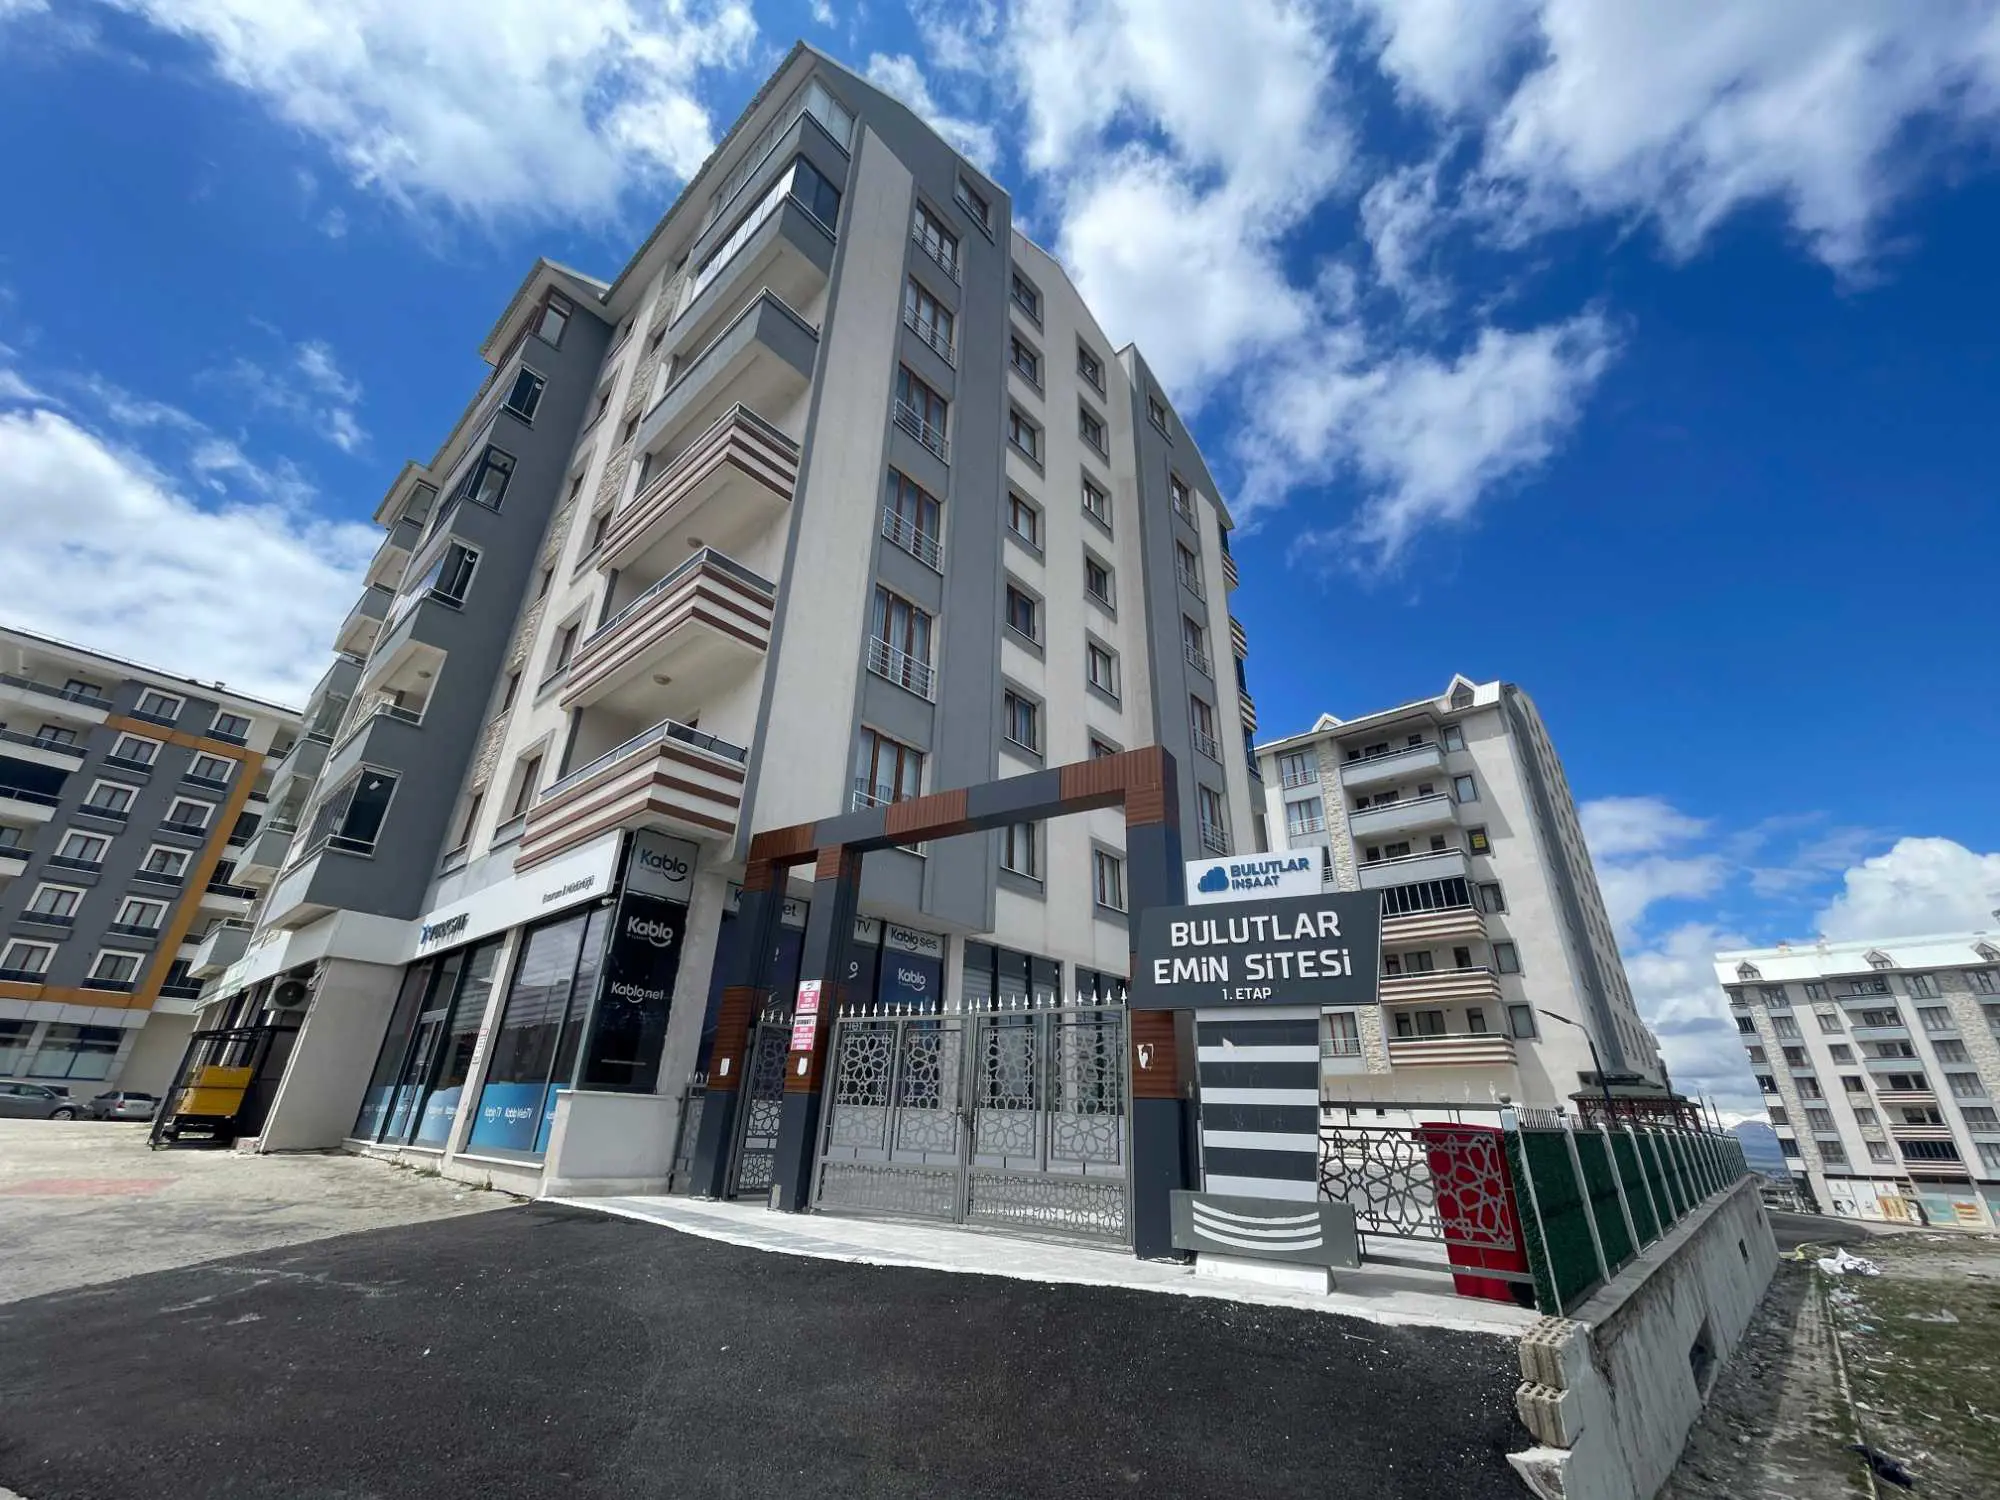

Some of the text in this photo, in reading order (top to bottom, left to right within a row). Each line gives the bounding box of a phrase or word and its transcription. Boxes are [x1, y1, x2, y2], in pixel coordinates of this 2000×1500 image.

[640, 848, 688, 875] Kablo
[1230, 857, 1310, 877] BULUTLAR
[627, 915, 674, 940] Kablo
[1170, 910, 1342, 948] BULUTLAR
[897, 967, 927, 985] Kablo
[1221, 986, 1273, 1001] 1. ETAP
